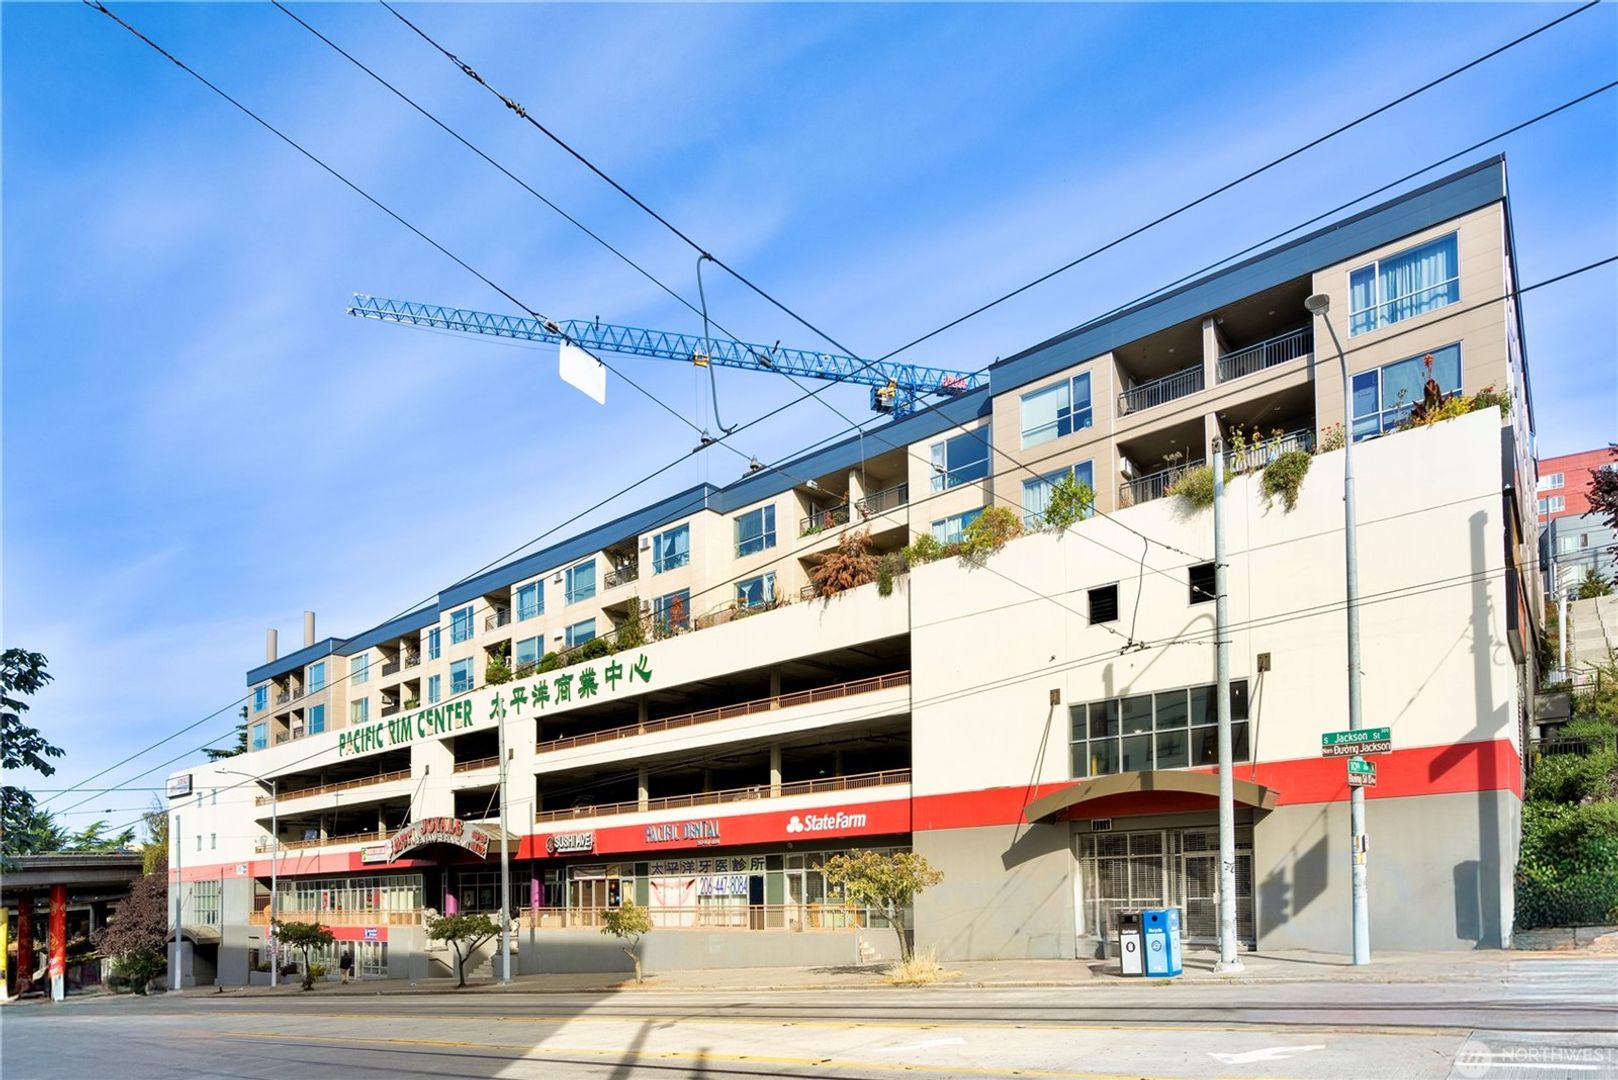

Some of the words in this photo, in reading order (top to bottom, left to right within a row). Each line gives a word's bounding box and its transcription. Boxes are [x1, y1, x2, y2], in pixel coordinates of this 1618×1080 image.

[489, 653, 653, 720] 太平洋商業中心
[339, 722, 384, 757] PACIFIC
[388, 715, 413, 746] RIM
[417, 699, 476, 740] CENTER
[1324, 736, 1329, 745] S
[1334, 732, 1368, 744] Jackson
[1372, 732, 1381, 740] St
[1360, 742, 1391, 753] Jackson
[646, 824, 680, 843] PACIFIC
[682, 819, 720, 840] DENTAL
[554, 835, 577, 850] SUSHI
